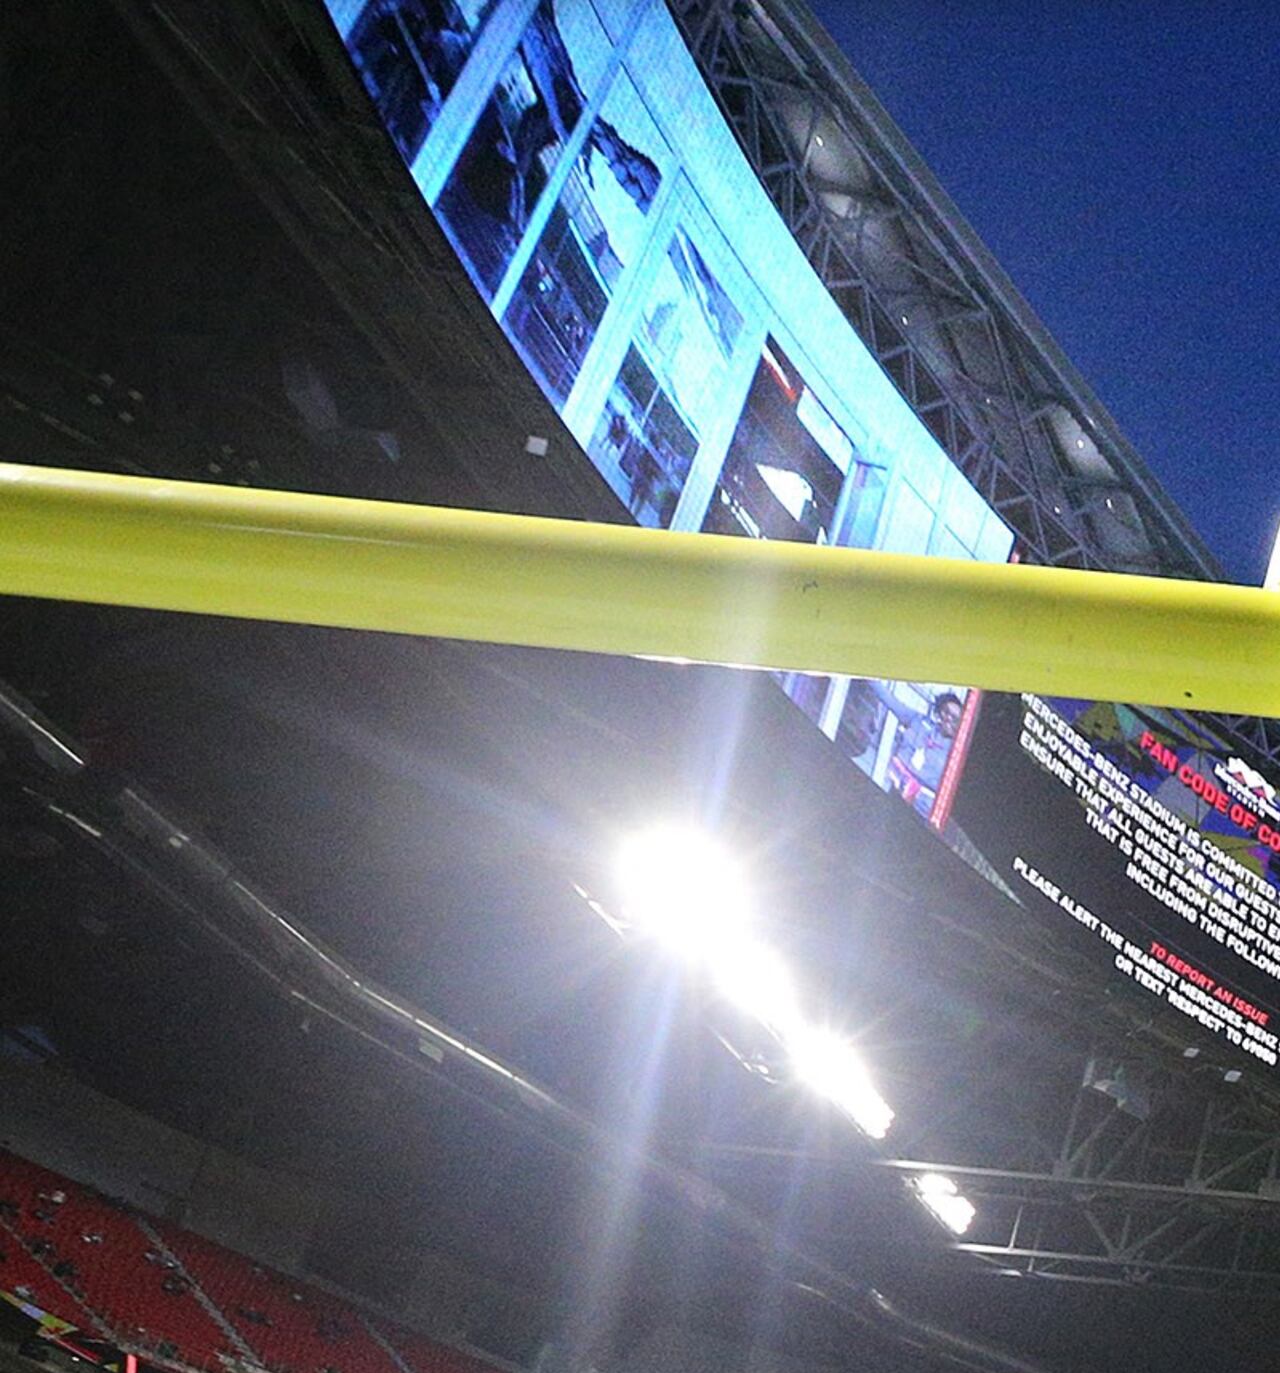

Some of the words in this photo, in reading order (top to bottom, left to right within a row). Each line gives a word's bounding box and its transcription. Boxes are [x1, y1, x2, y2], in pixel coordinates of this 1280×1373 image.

[1020, 730, 1074, 787] ENSURE
[1075, 778, 1109, 814] THAT
[1108, 808, 1133, 837] ALL
[1135, 829, 1185, 873] GUESTS
[1186, 867, 1213, 892] ARE
[1213, 885, 1249, 918] ABLE
[1250, 913, 1267, 933] TO
[1022, 693, 1130, 791] MERCEDES-BENZ
[1130, 784, 1186, 836] STADIUM
[1187, 828, 1199, 846] IS
[1202, 840, 1276, 900] COMMITTED
[1024, 712, 1099, 787] ENJOYABLE
[1099, 781, 1177, 848] EXPERIENCE
[1179, 841, 1205, 869] FOR
[1207, 863, 1234, 889] OUR
[1140, 731, 1179, 772] FAN
[1180, 765, 1230, 812] CODE
[1230, 805, 1258, 829] OF
[1086, 808, 1120, 844] THAT
[1119, 836, 1133, 856] IS
[1134, 847, 1168, 883] FREE
[1170, 877, 1207, 911] FROM
[1126, 862, 1197, 924] INCLUDING
[1200, 915, 1226, 944] THE
[1014, 857, 1061, 903] PLEASE
[1060, 896, 1099, 932] ALERT
[1100, 923, 1124, 950] THE
[1124, 941, 1179, 986] NEAREST
[1179, 978, 1280, 1050] MERCEDES-BENZ
[1115, 954, 1133, 976] OR
[1135, 969, 1166, 995] TEXT
[1226, 1026, 1241, 1045] TO
[1150, 942, 1166, 959] TO
[1166, 954, 1214, 992] REPORT
[1213, 985, 1234, 1004] AN
[1233, 999, 1269, 1025] ISSUE
